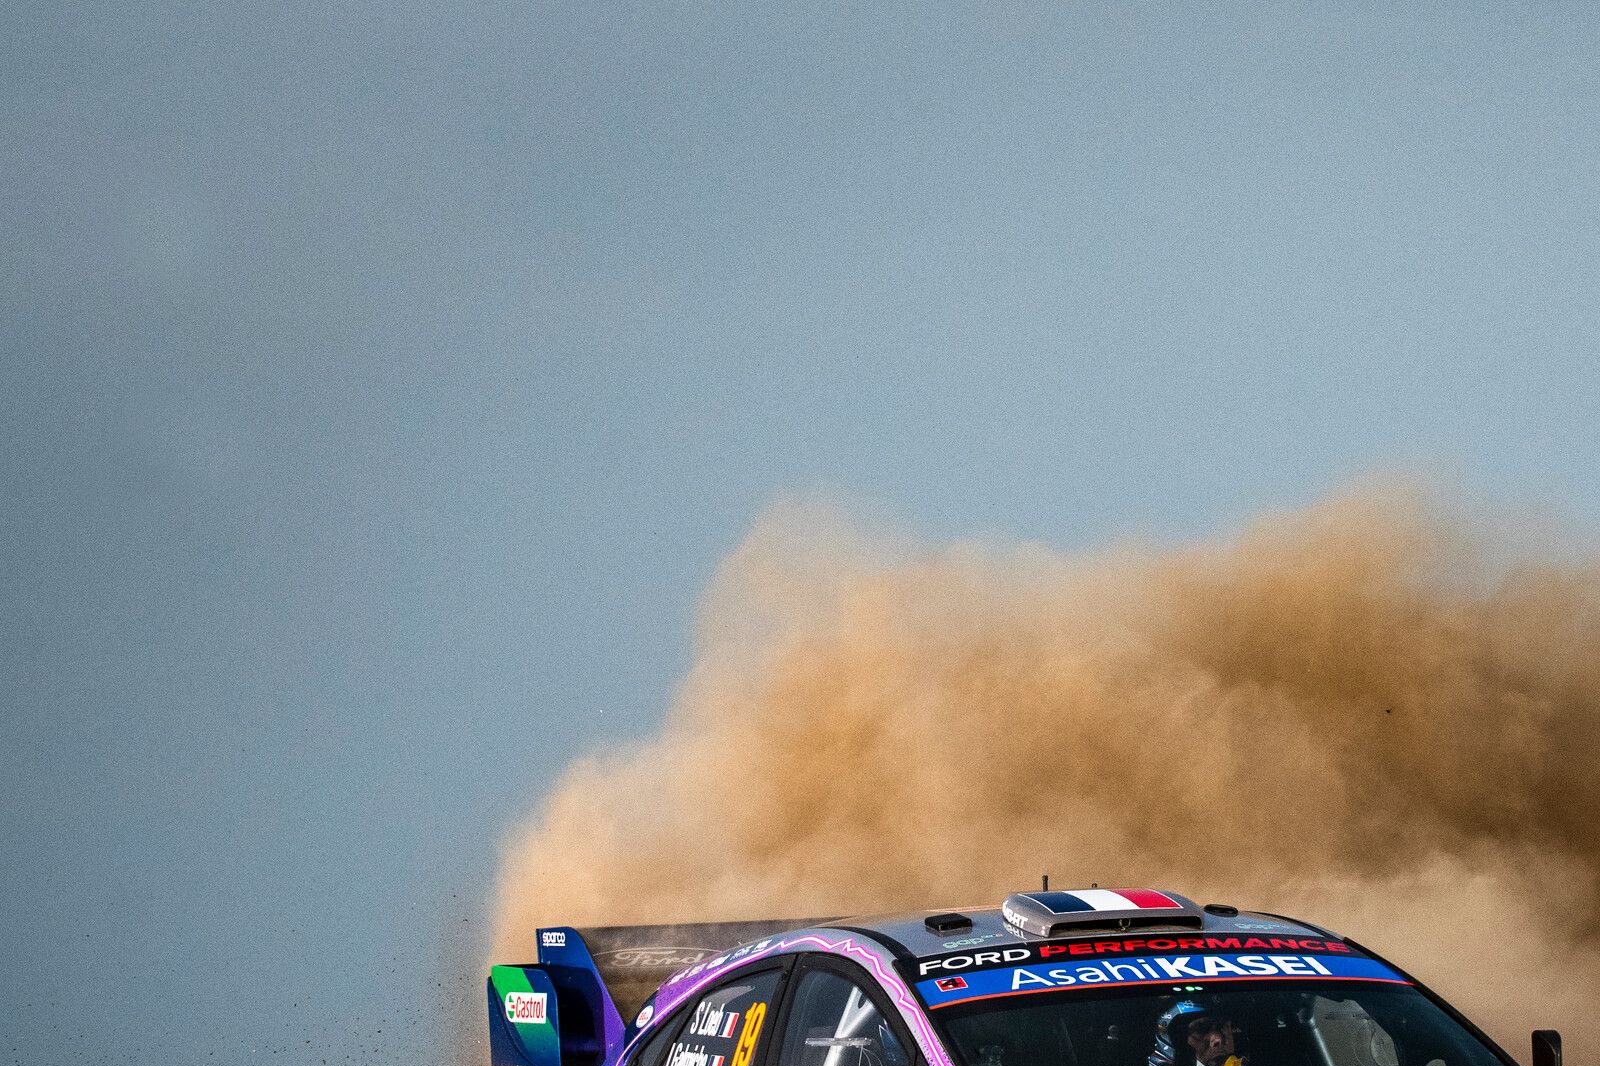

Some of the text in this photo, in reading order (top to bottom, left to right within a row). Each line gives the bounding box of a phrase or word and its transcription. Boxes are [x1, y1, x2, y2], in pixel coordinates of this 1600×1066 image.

[542, 931, 566, 947] sparco
[611, 950, 705, 967] Ford
[919, 937, 1351, 976] FORD PERFORMANCE
[515, 996, 545, 1019] Castrol
[698, 1001, 726, 1037] Loeb
